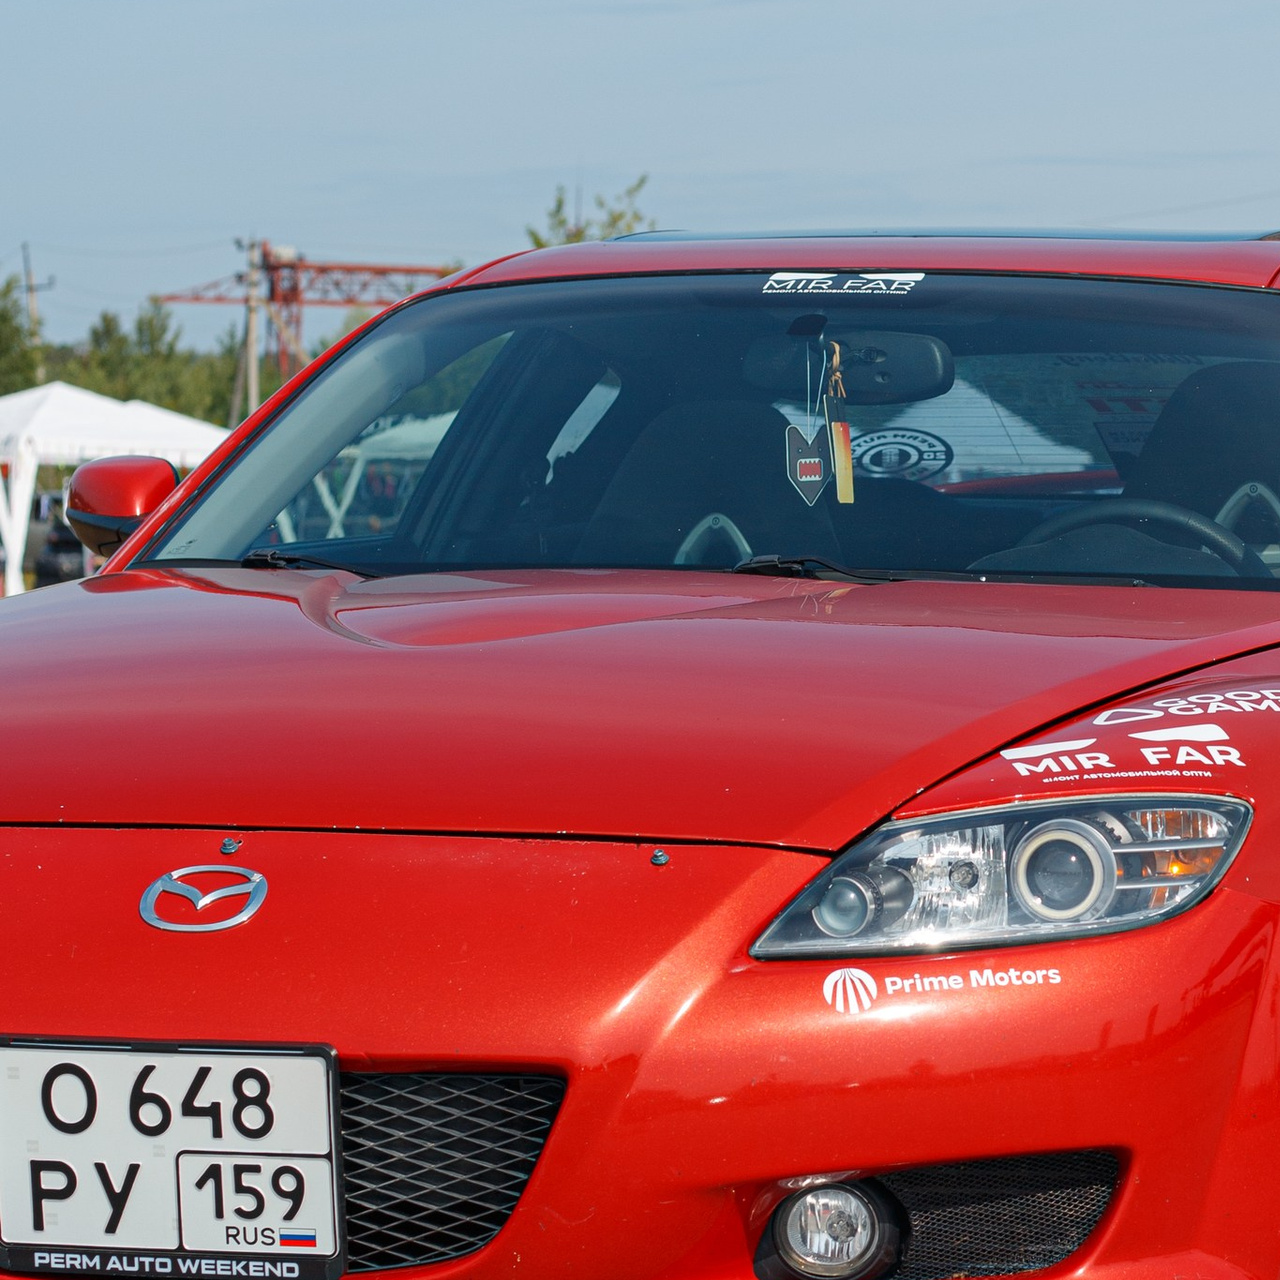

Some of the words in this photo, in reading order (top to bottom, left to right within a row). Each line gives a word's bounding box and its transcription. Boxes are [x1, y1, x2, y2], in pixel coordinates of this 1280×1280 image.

[763, 280, 833, 290] MIR
[843, 280, 915, 291] FAR
[1012, 752, 1116, 776] MIR
[1140, 746, 1246, 767] FAR
[1083, 769, 1181, 781] АВТОМОБИЛЬНОЙ
[885, 969, 965, 995] Prime
[969, 964, 1062, 988] Motors
[41, 1062, 97, 1135] O
[129, 1064, 275, 1140] 648
[30, 1159, 141, 1235] PY
[195, 1162, 306, 1222] 159
[226, 1226, 276, 1246] RUS
[34, 1252, 101, 1271] PERM
[106, 1255, 172, 1274] AUTO
[177, 1258, 299, 1279] WEEKEND
